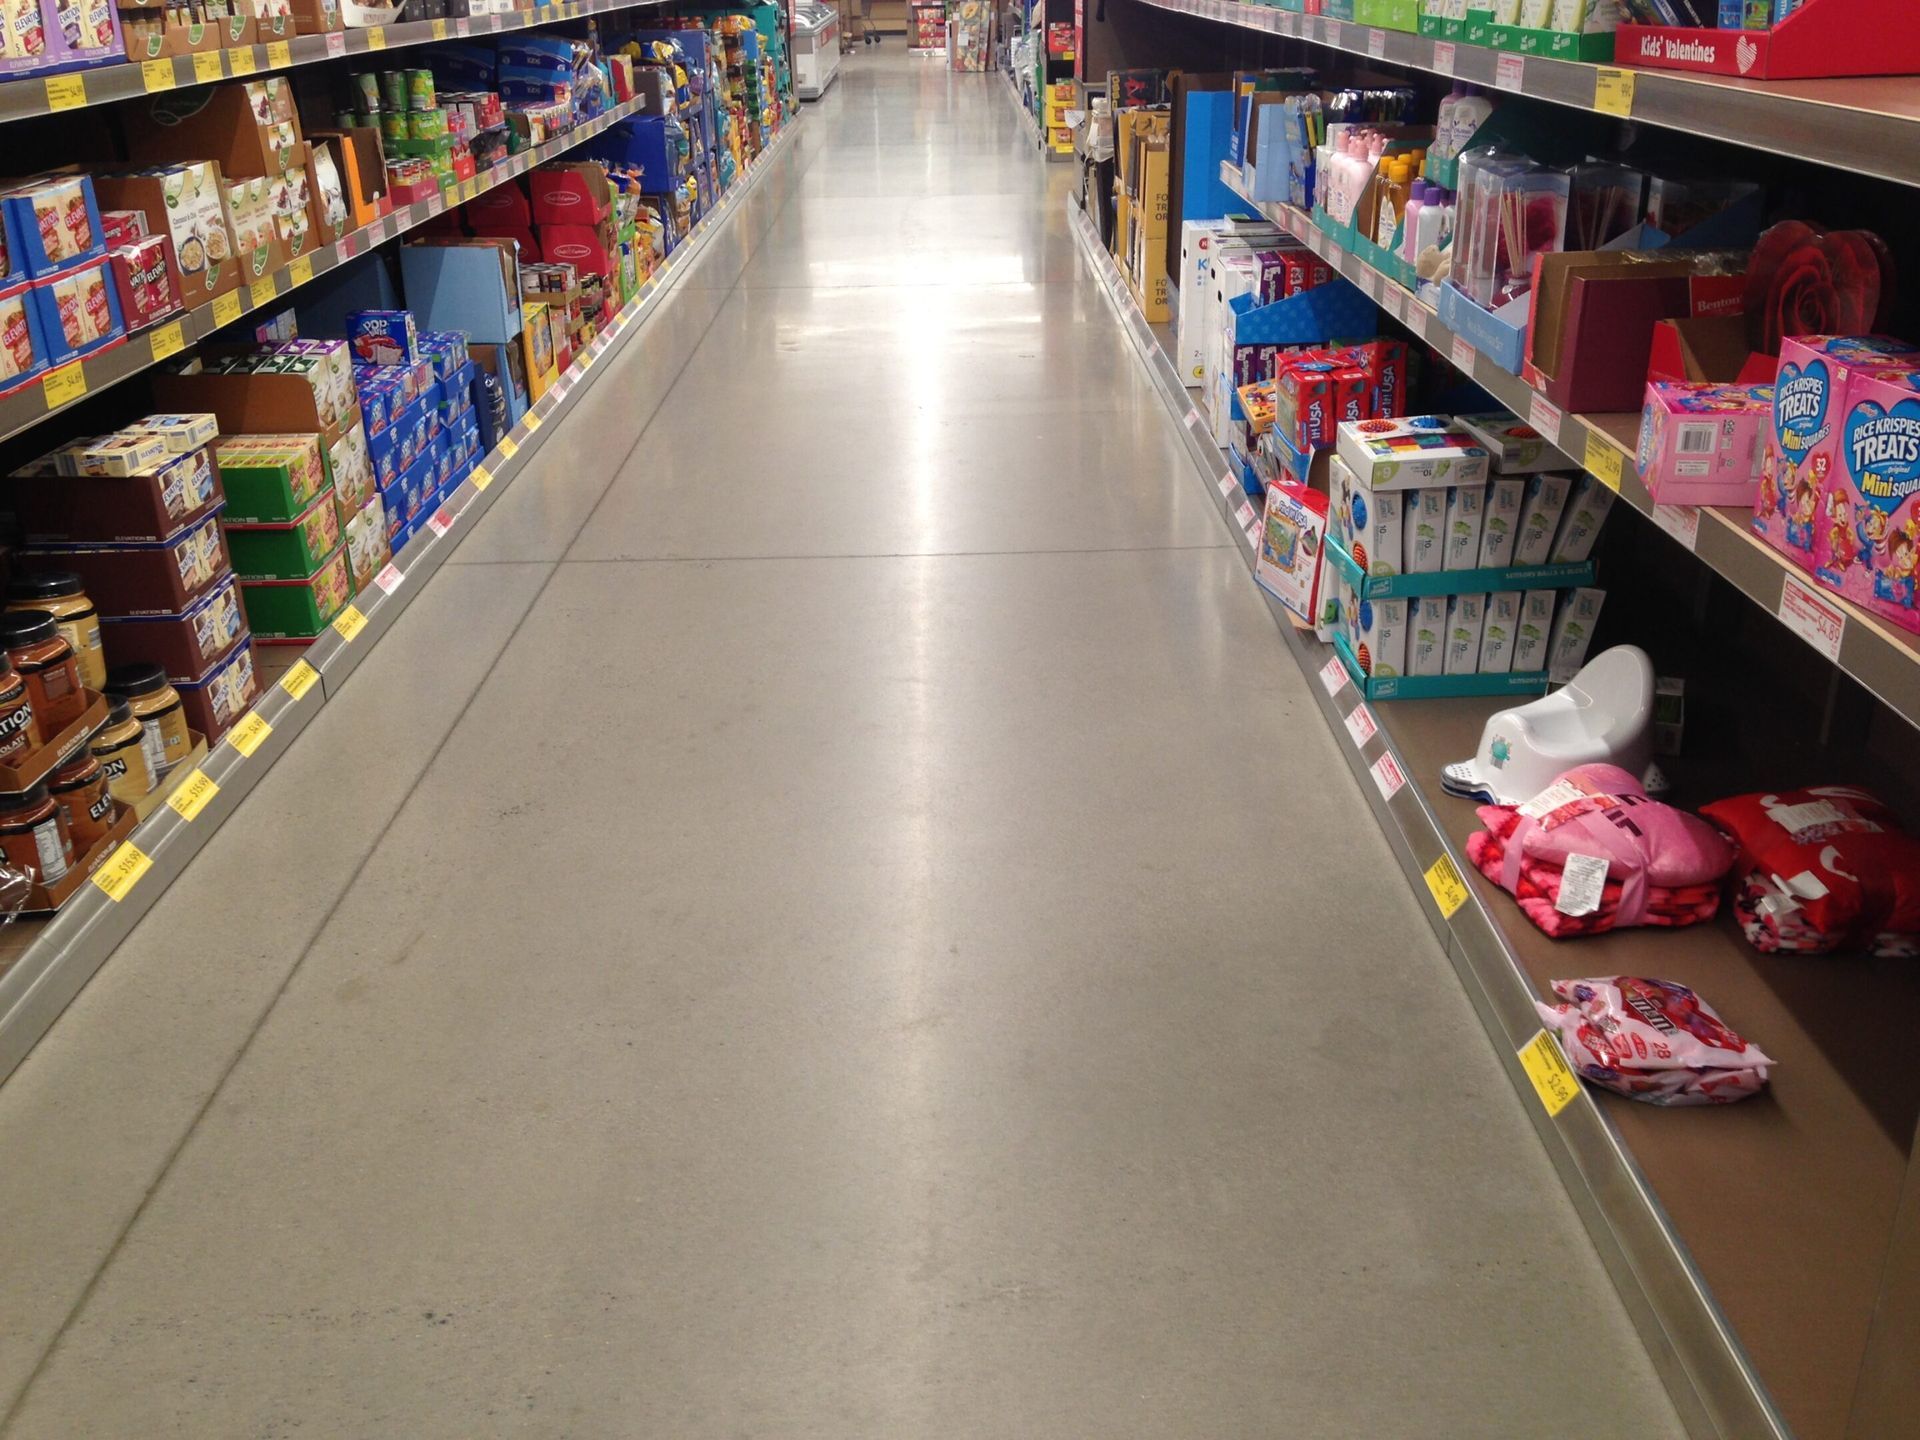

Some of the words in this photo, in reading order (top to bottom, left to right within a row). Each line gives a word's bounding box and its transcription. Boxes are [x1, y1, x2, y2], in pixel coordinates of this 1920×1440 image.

[1641, 35, 1664, 58] Kids'
[1666, 38, 1716, 65] Valentines
[1794, 376, 1824, 396] KRISPIES
[1778, 393, 1820, 427] TREATS
[1782, 427, 1801, 450] Mini
[1853, 420, 1876, 443] RICE
[1875, 417, 1920, 438] KRISPIES
[1815, 458, 1826, 471] 32
[1852, 434, 1920, 472] TREATS
[1861, 472, 1892, 497] Mini
[1892, 478, 1920, 498] SQUA
[189, 776, 210, 799] $15.99
[119, 850, 141, 875] $15.99
[1654, 1042, 1672, 1060] 28
